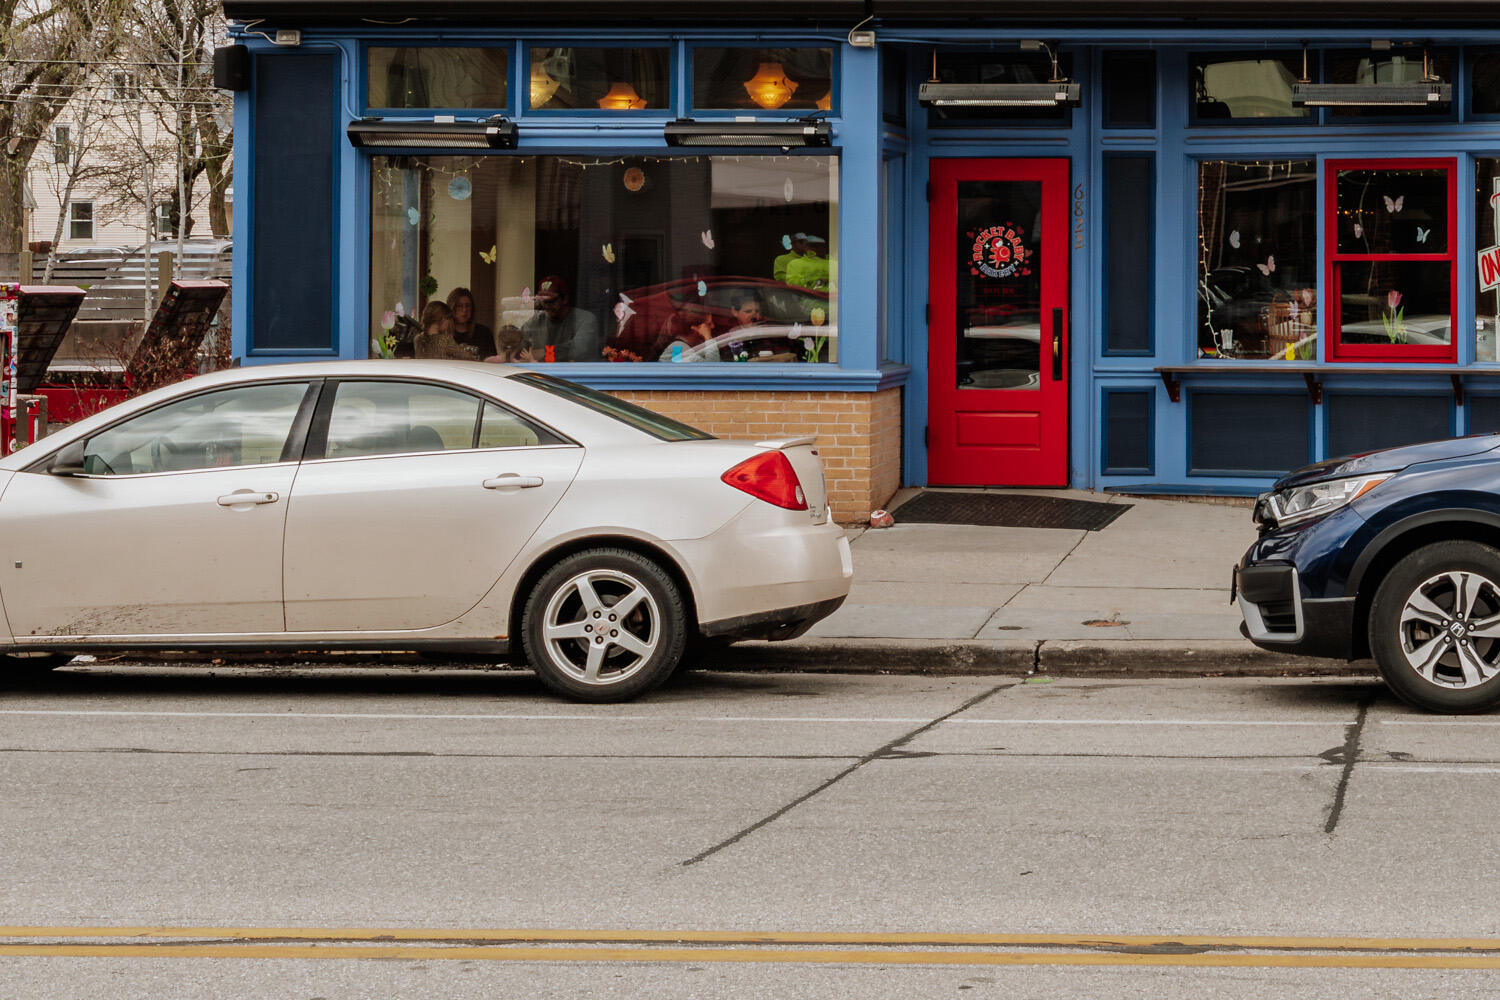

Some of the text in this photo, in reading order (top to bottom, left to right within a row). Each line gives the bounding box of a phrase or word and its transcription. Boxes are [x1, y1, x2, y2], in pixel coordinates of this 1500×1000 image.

[1074, 183, 1084, 250] 6822
[972, 226, 1024, 262] ROCKET BABY
[980, 263, 1016, 278] BAKERY
